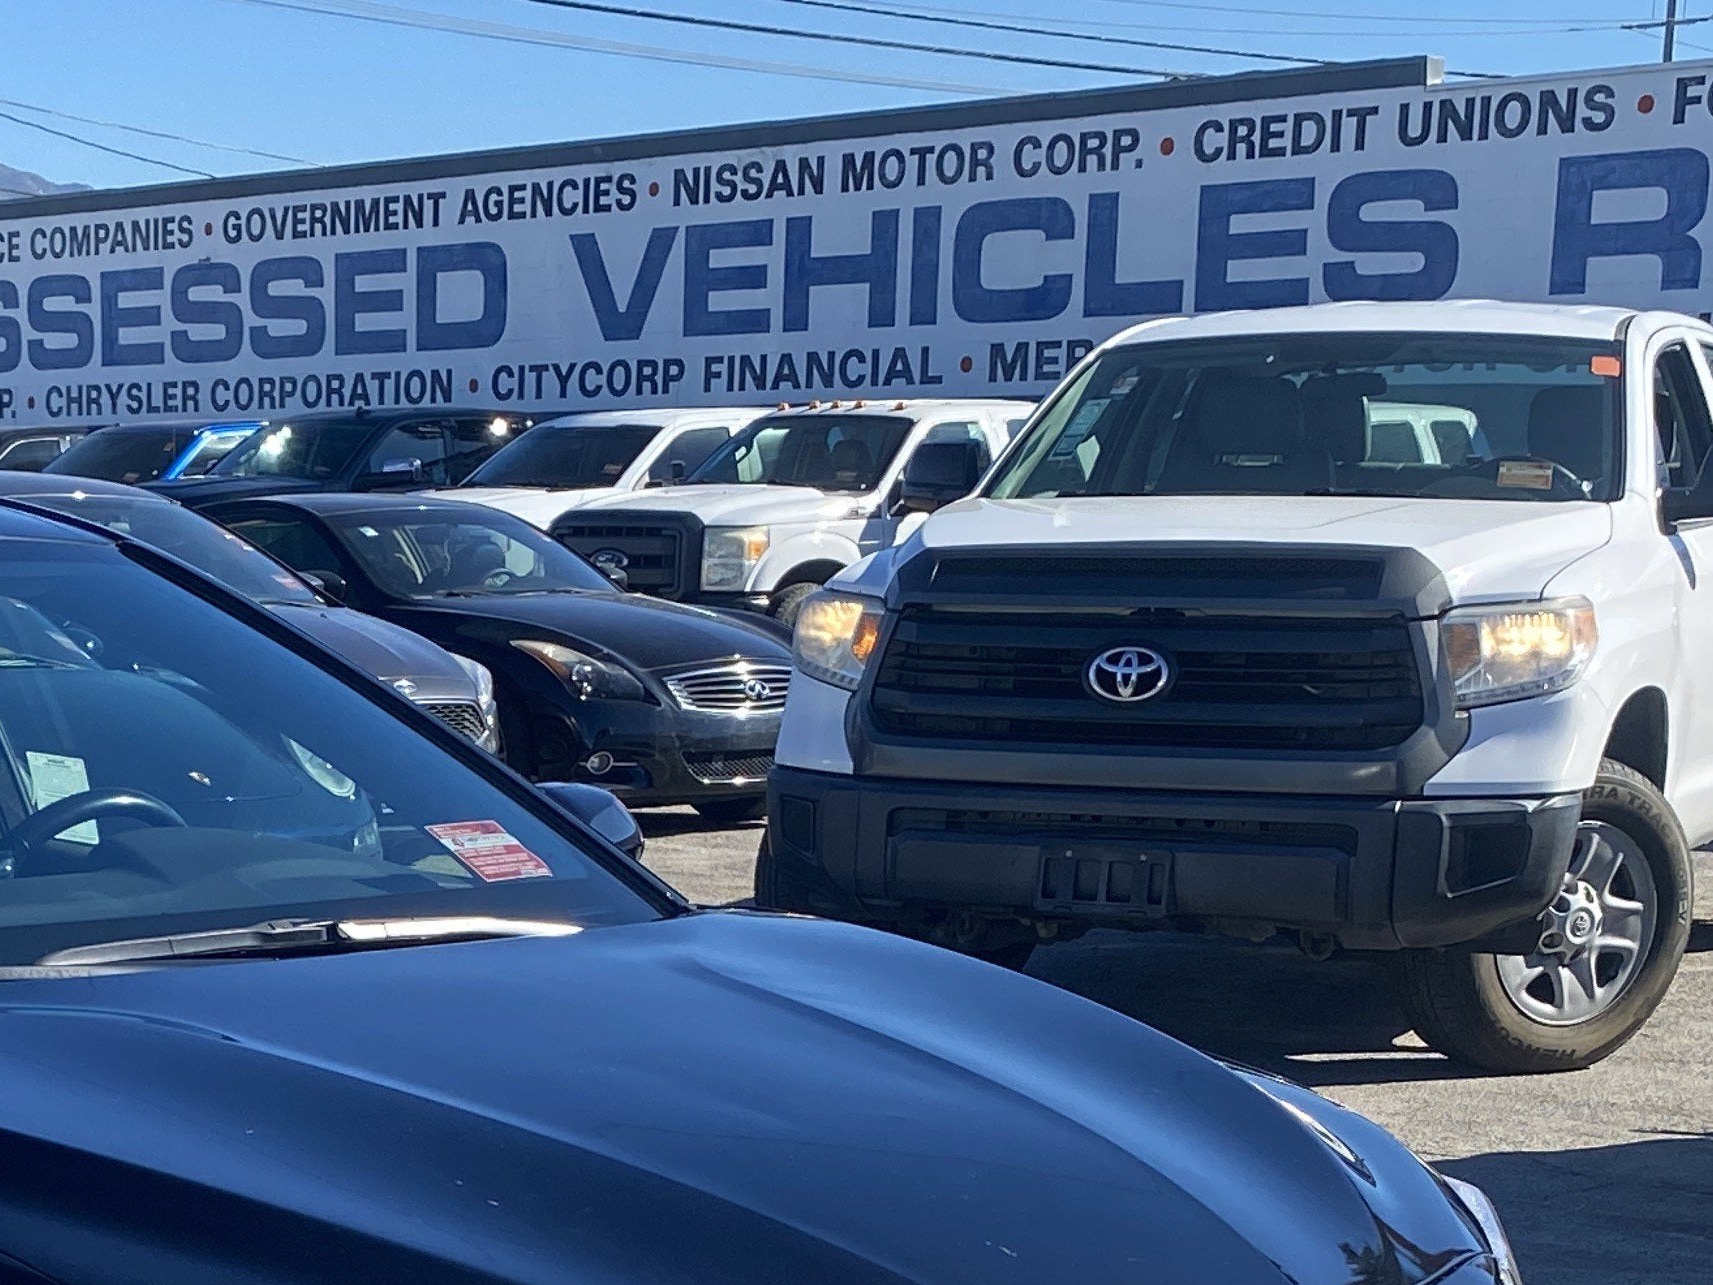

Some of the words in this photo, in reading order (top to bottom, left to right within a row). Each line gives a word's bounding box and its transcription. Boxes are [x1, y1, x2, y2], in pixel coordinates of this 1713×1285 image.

[30, 214, 193, 261] COMPANIES
[222, 190, 447, 244] GOVERNMENT
[457, 173, 638, 225] AGENCIES
[671, 156, 826, 206] NISSAN
[840, 140, 994, 193] MOTOR
[1013, 127, 1143, 178] CORP.
[1193, 105, 1379, 163] CREDIT
[1397, 84, 1615, 147] UNIONS
[569, 168, 1459, 342] VEHICLES
[1549, 147, 1709, 296] R
[44, 380, 200, 418] CHRYSLER
[210, 368, 453, 414] CORPORATION
[490, 357, 685, 402] CITYCORP
[703, 345, 943, 392] FINANCIAL
